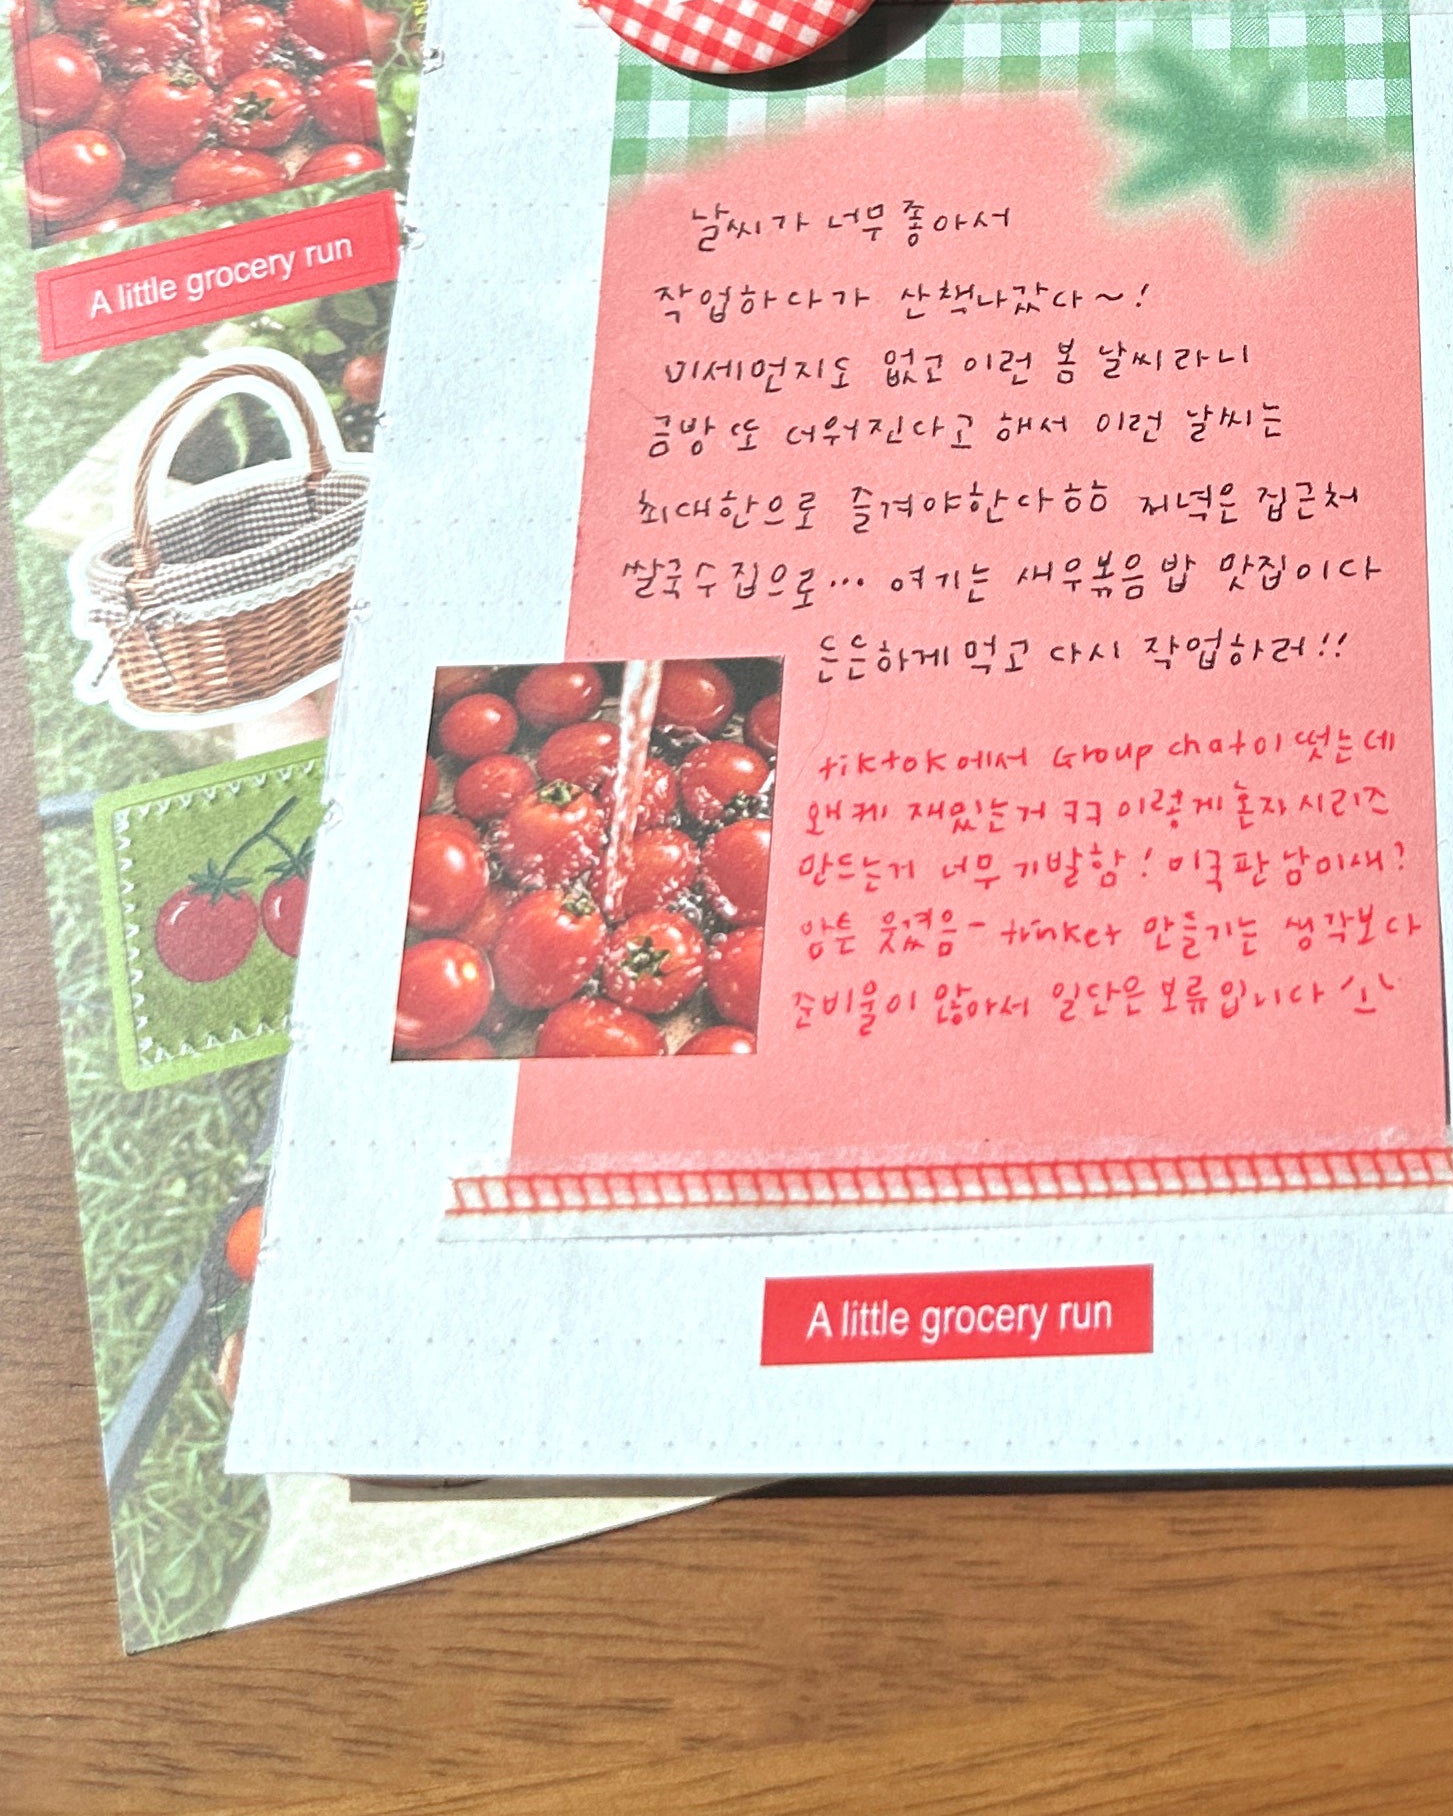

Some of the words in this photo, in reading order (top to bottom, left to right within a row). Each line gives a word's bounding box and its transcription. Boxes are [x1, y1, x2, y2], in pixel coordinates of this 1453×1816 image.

[692, 202, 809, 252] 날씨가
[828, 203, 885, 242] 너무
[903, 200, 1011, 247] 좋아서
[89, 289, 113, 320] A
[117, 275, 178, 313] little
[187, 249, 297, 303] grocery
[305, 238, 354, 268] run
[654, 284, 870, 323] 작업하다가
[884, 347, 943, 386] 없고
[964, 350, 1033, 385] 이런
[648, 415, 716, 458] 금방
[731, 418, 760, 451] 또
[787, 413, 974, 449] 더워진다고
[996, 411, 1068, 442] 해서
[1097, 410, 1162, 443] 이런
[1186, 402, 1282, 442] 날씨는
[1138, 482, 1239, 525] 저녁은
[891, 563, 991, 604] 여기는
[818, 633, 949, 684] 든든하게
[964, 633, 1030, 676] 먹고
[1050, 638, 1120, 664] 다시
[1117, 788, 1223, 830] 이렇게
[942, 853, 1001, 890] 너무
[1285, 903, 1422, 951] 생각보다
[805, 1301, 833, 1341] A
[842, 1299, 911, 1338] little
[921, 1301, 1047, 1345] grocery
[1059, 1299, 1112, 1330] run
